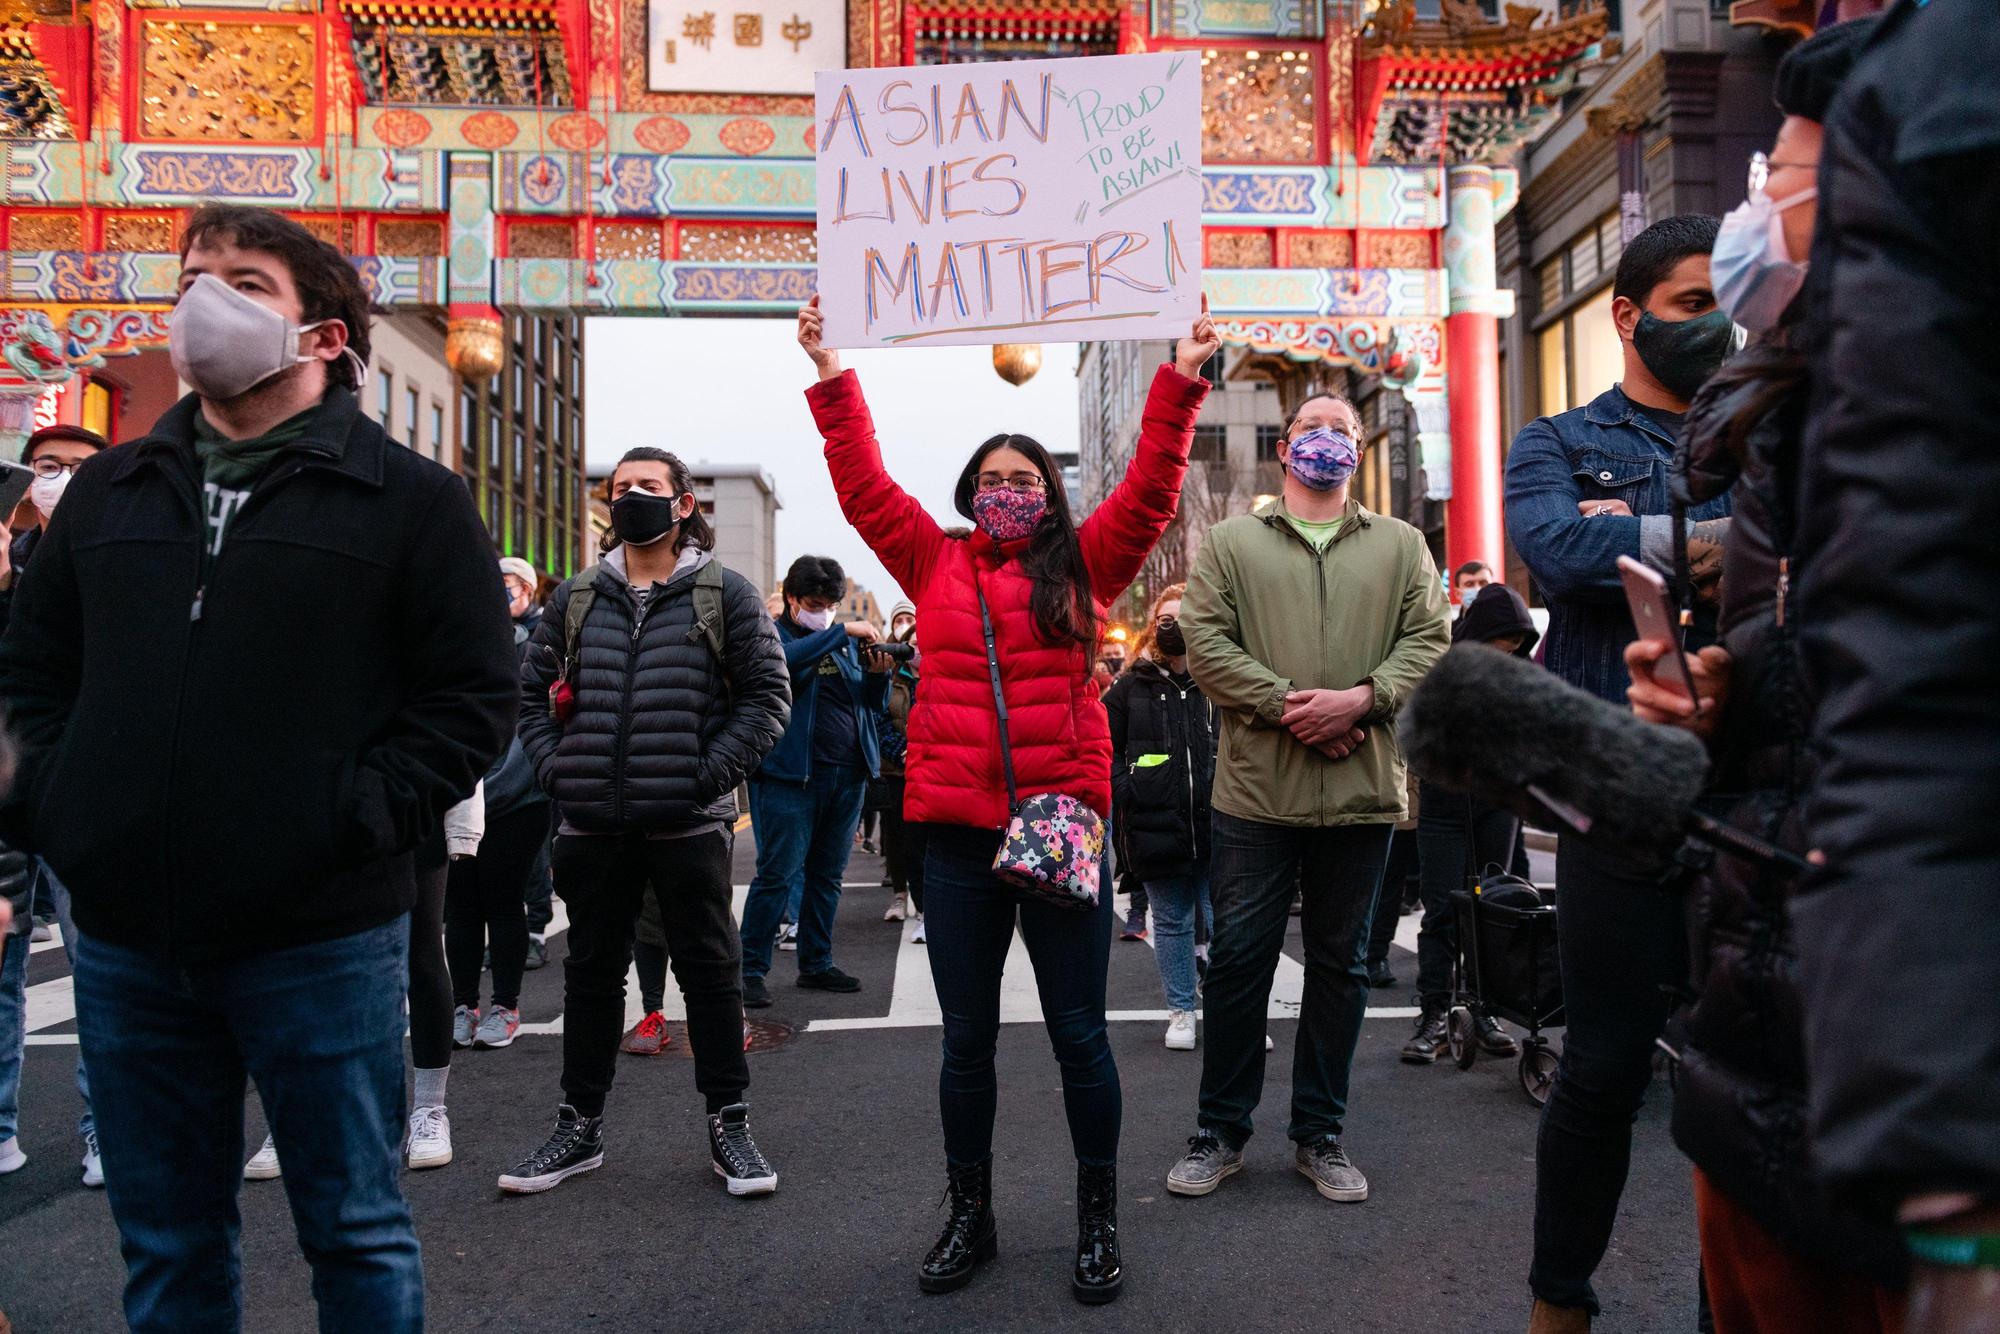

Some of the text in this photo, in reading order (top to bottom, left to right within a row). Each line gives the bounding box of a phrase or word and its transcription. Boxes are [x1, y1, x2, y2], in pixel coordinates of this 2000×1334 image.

[820, 72, 1052, 157] ASIAN
[1067, 85, 1165, 142] PROUD
[1076, 125, 1155, 174] TO BE
[1102, 141, 1184, 200] ASIAN!
[833, 153, 1027, 230] LIVES
[864, 219, 1188, 336] MATTER!
